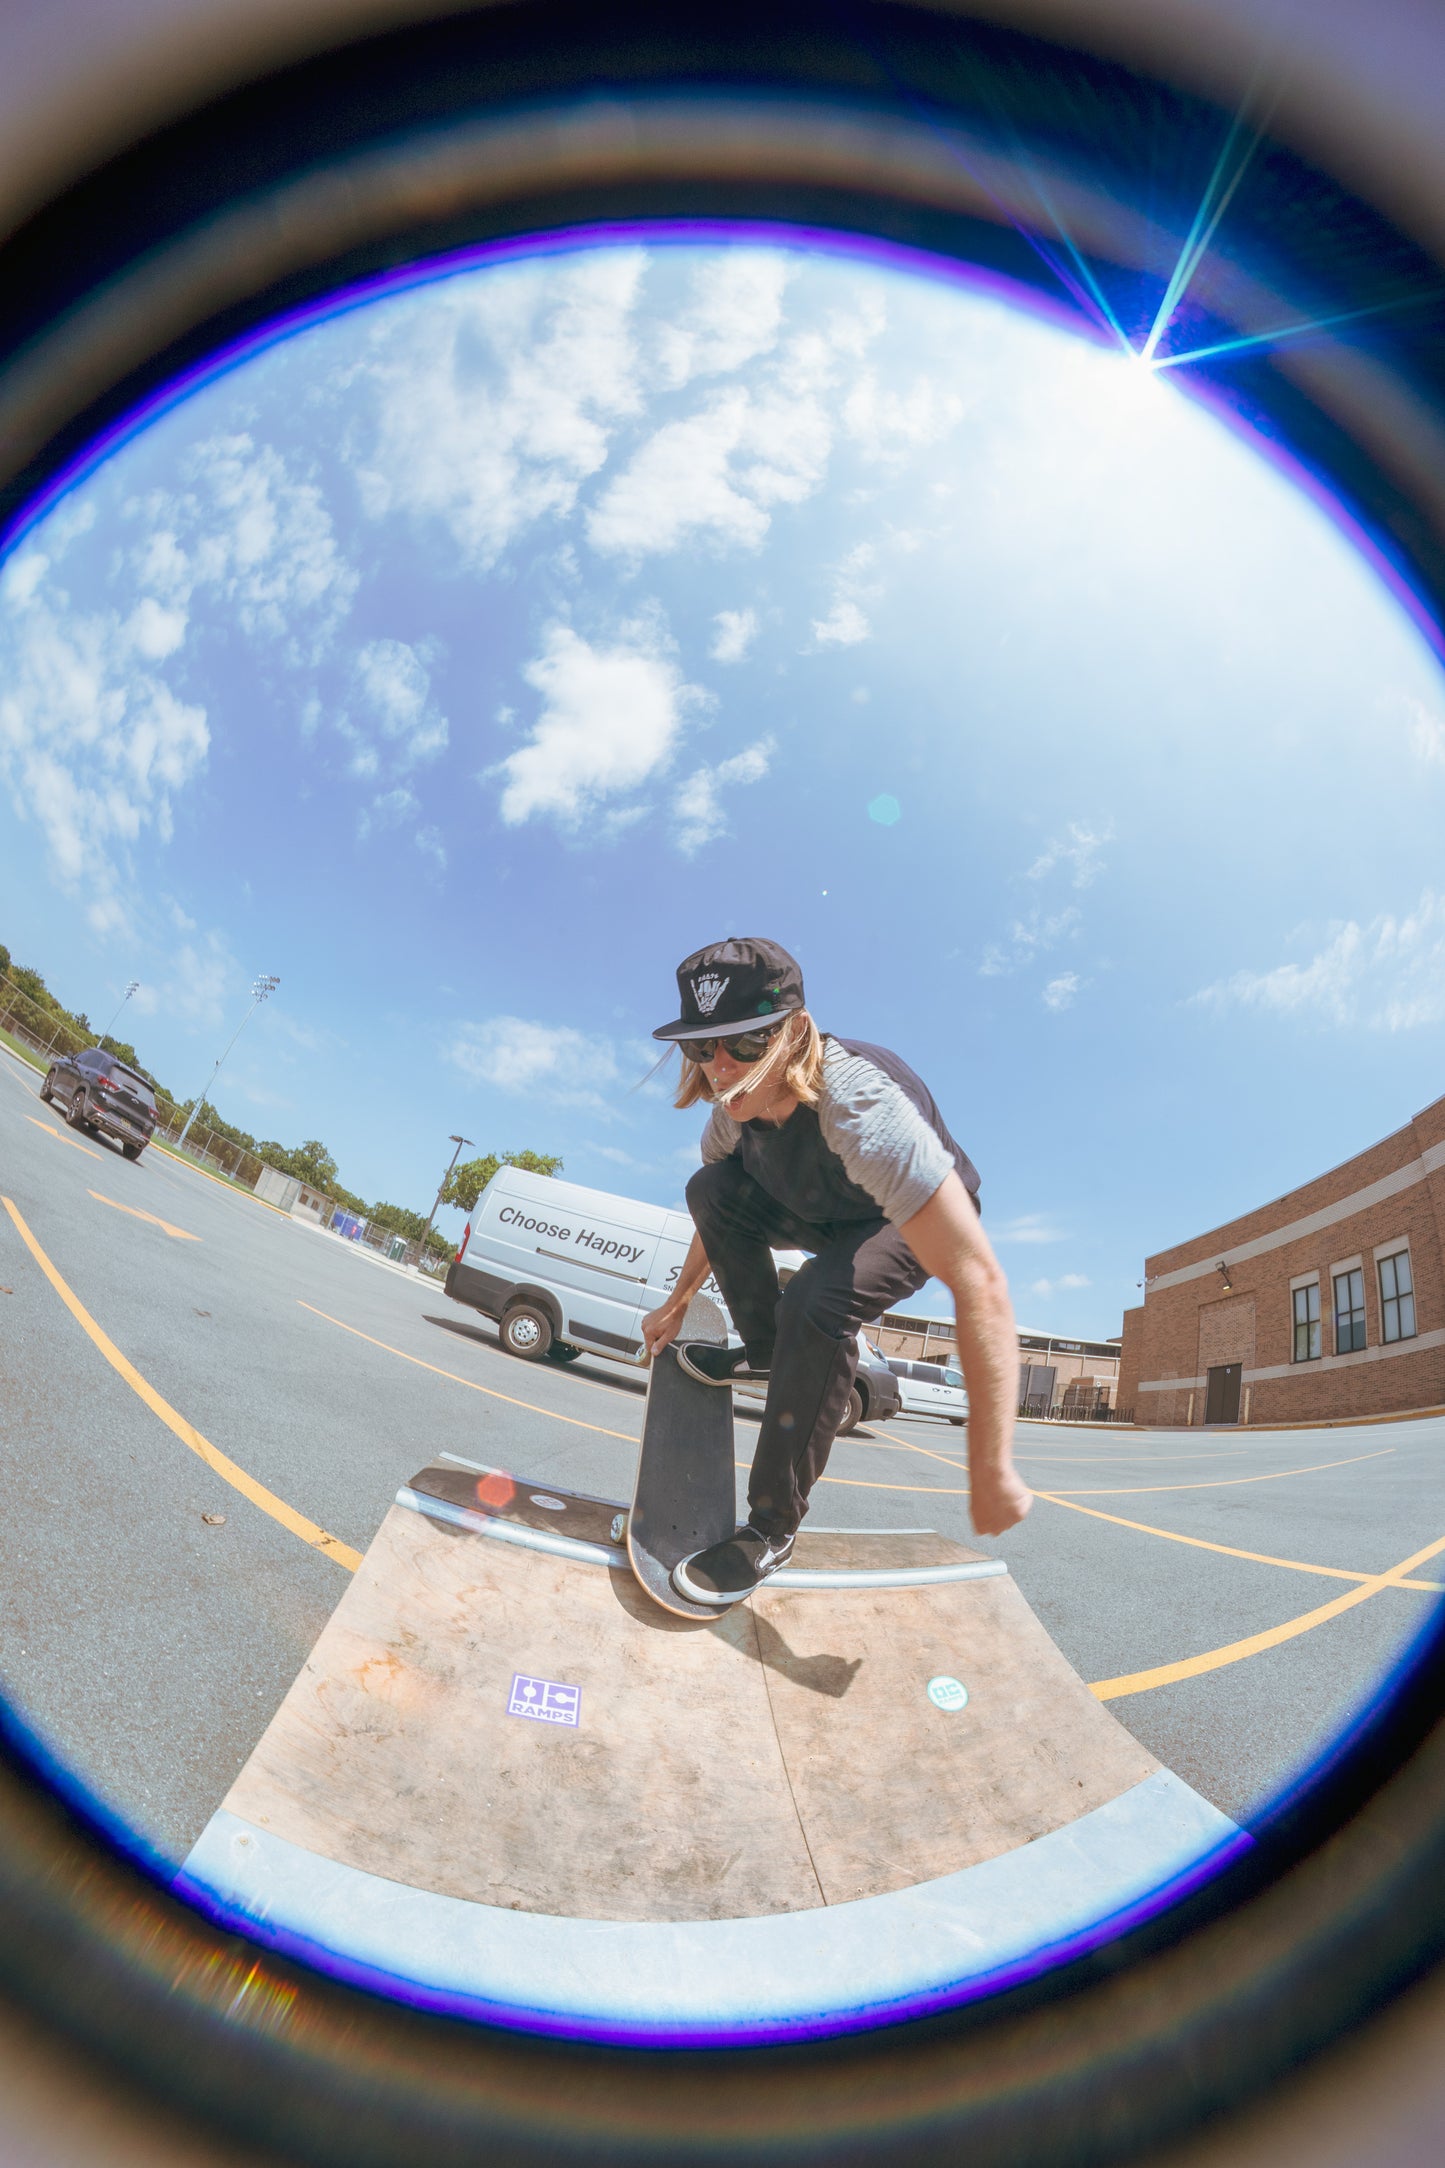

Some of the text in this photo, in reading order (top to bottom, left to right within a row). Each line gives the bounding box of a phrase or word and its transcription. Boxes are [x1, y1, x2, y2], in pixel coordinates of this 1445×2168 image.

[499, 1207, 645, 1263] Choose Happy
[512, 1703, 574, 1722] RAMPS
